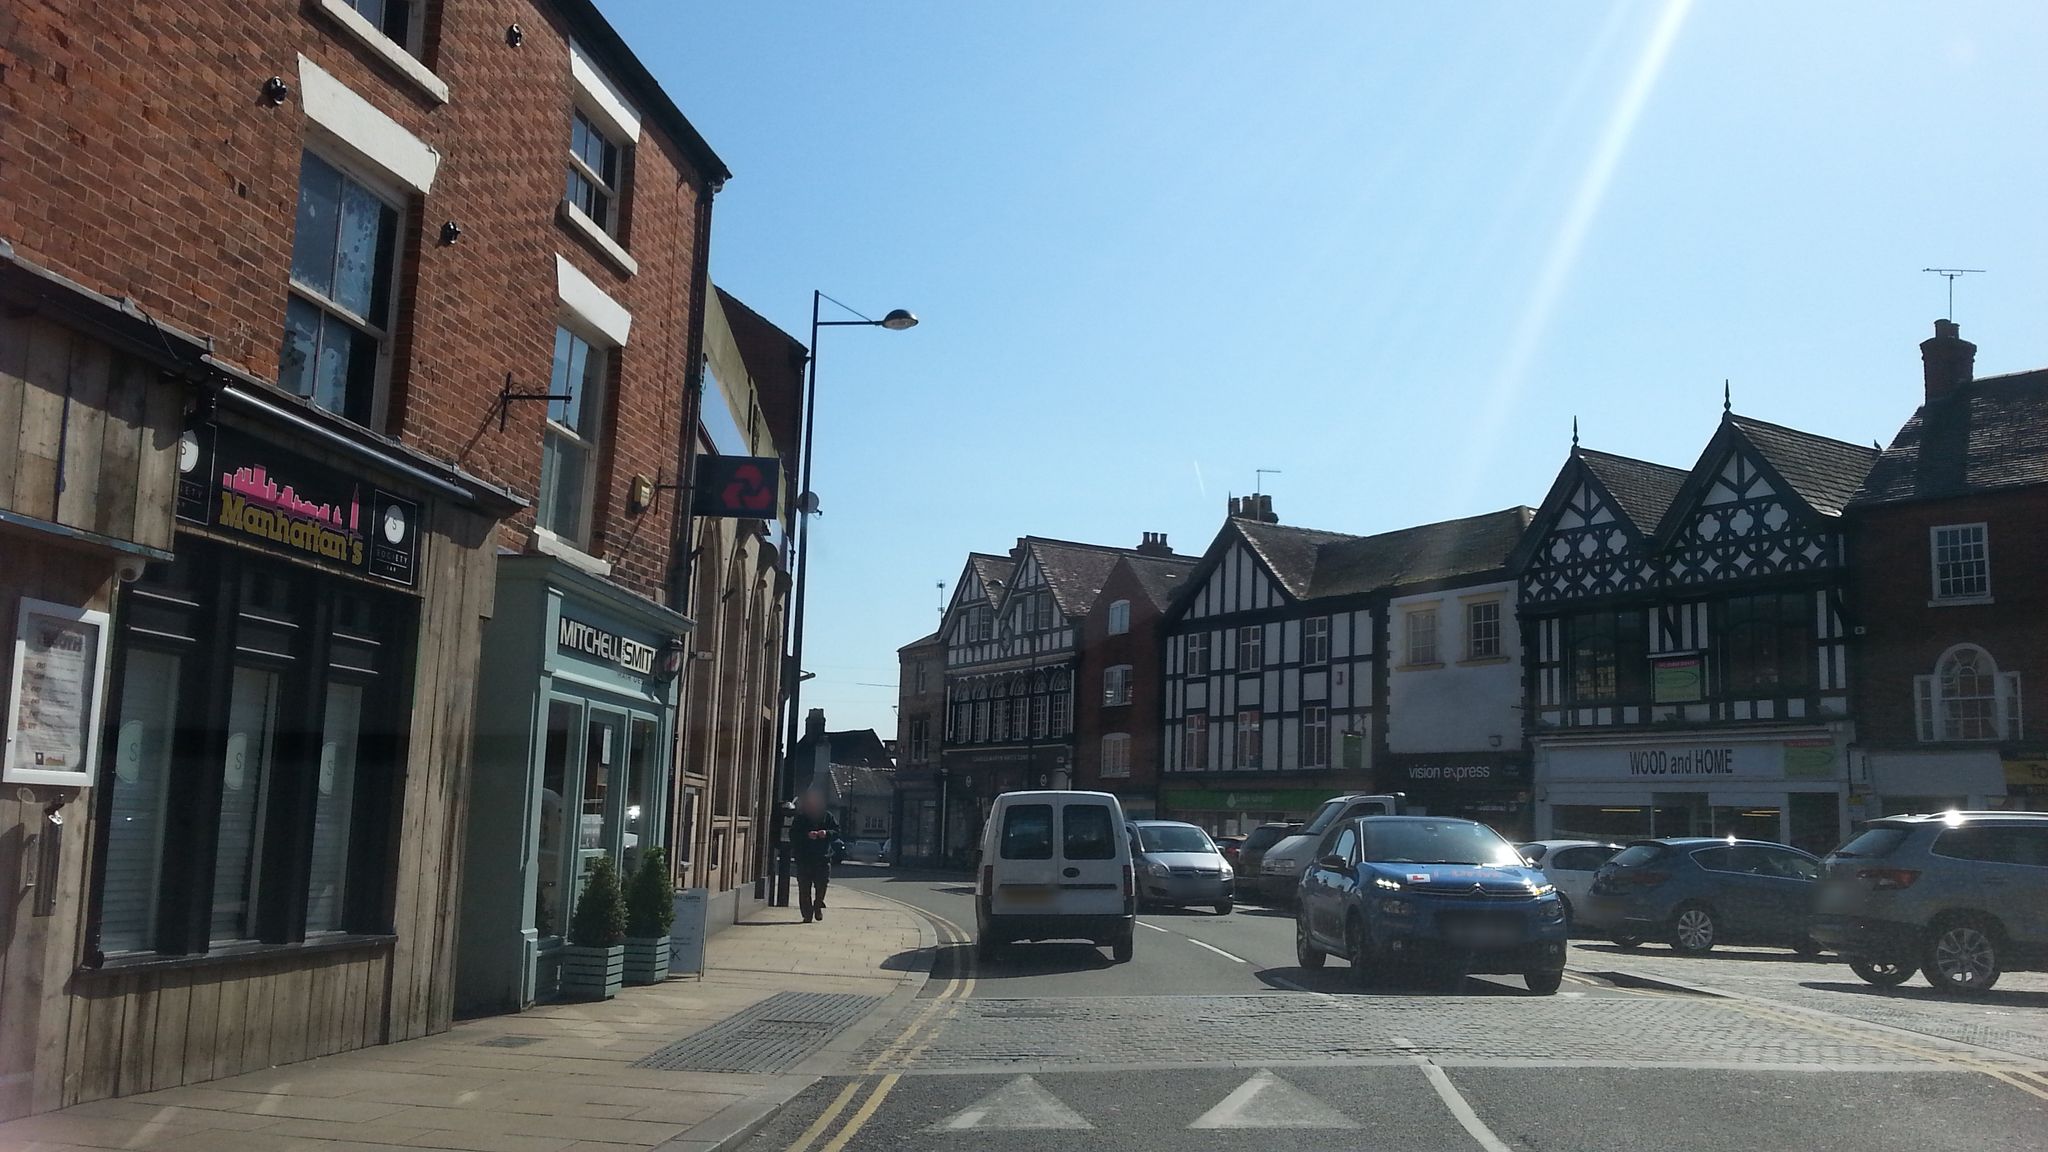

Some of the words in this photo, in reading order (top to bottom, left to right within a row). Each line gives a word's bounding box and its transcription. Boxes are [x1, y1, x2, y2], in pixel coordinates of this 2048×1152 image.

[219, 490, 363, 566] Manhattan's
[560, 617, 621, 662] MITCHELL
[1408, 764, 1440, 779] vision
[1443, 766, 1490, 782] express
[1629, 751, 1667, 775] WOOD
[1670, 750, 1692, 774] and
[1695, 749, 1733, 774] HOME
